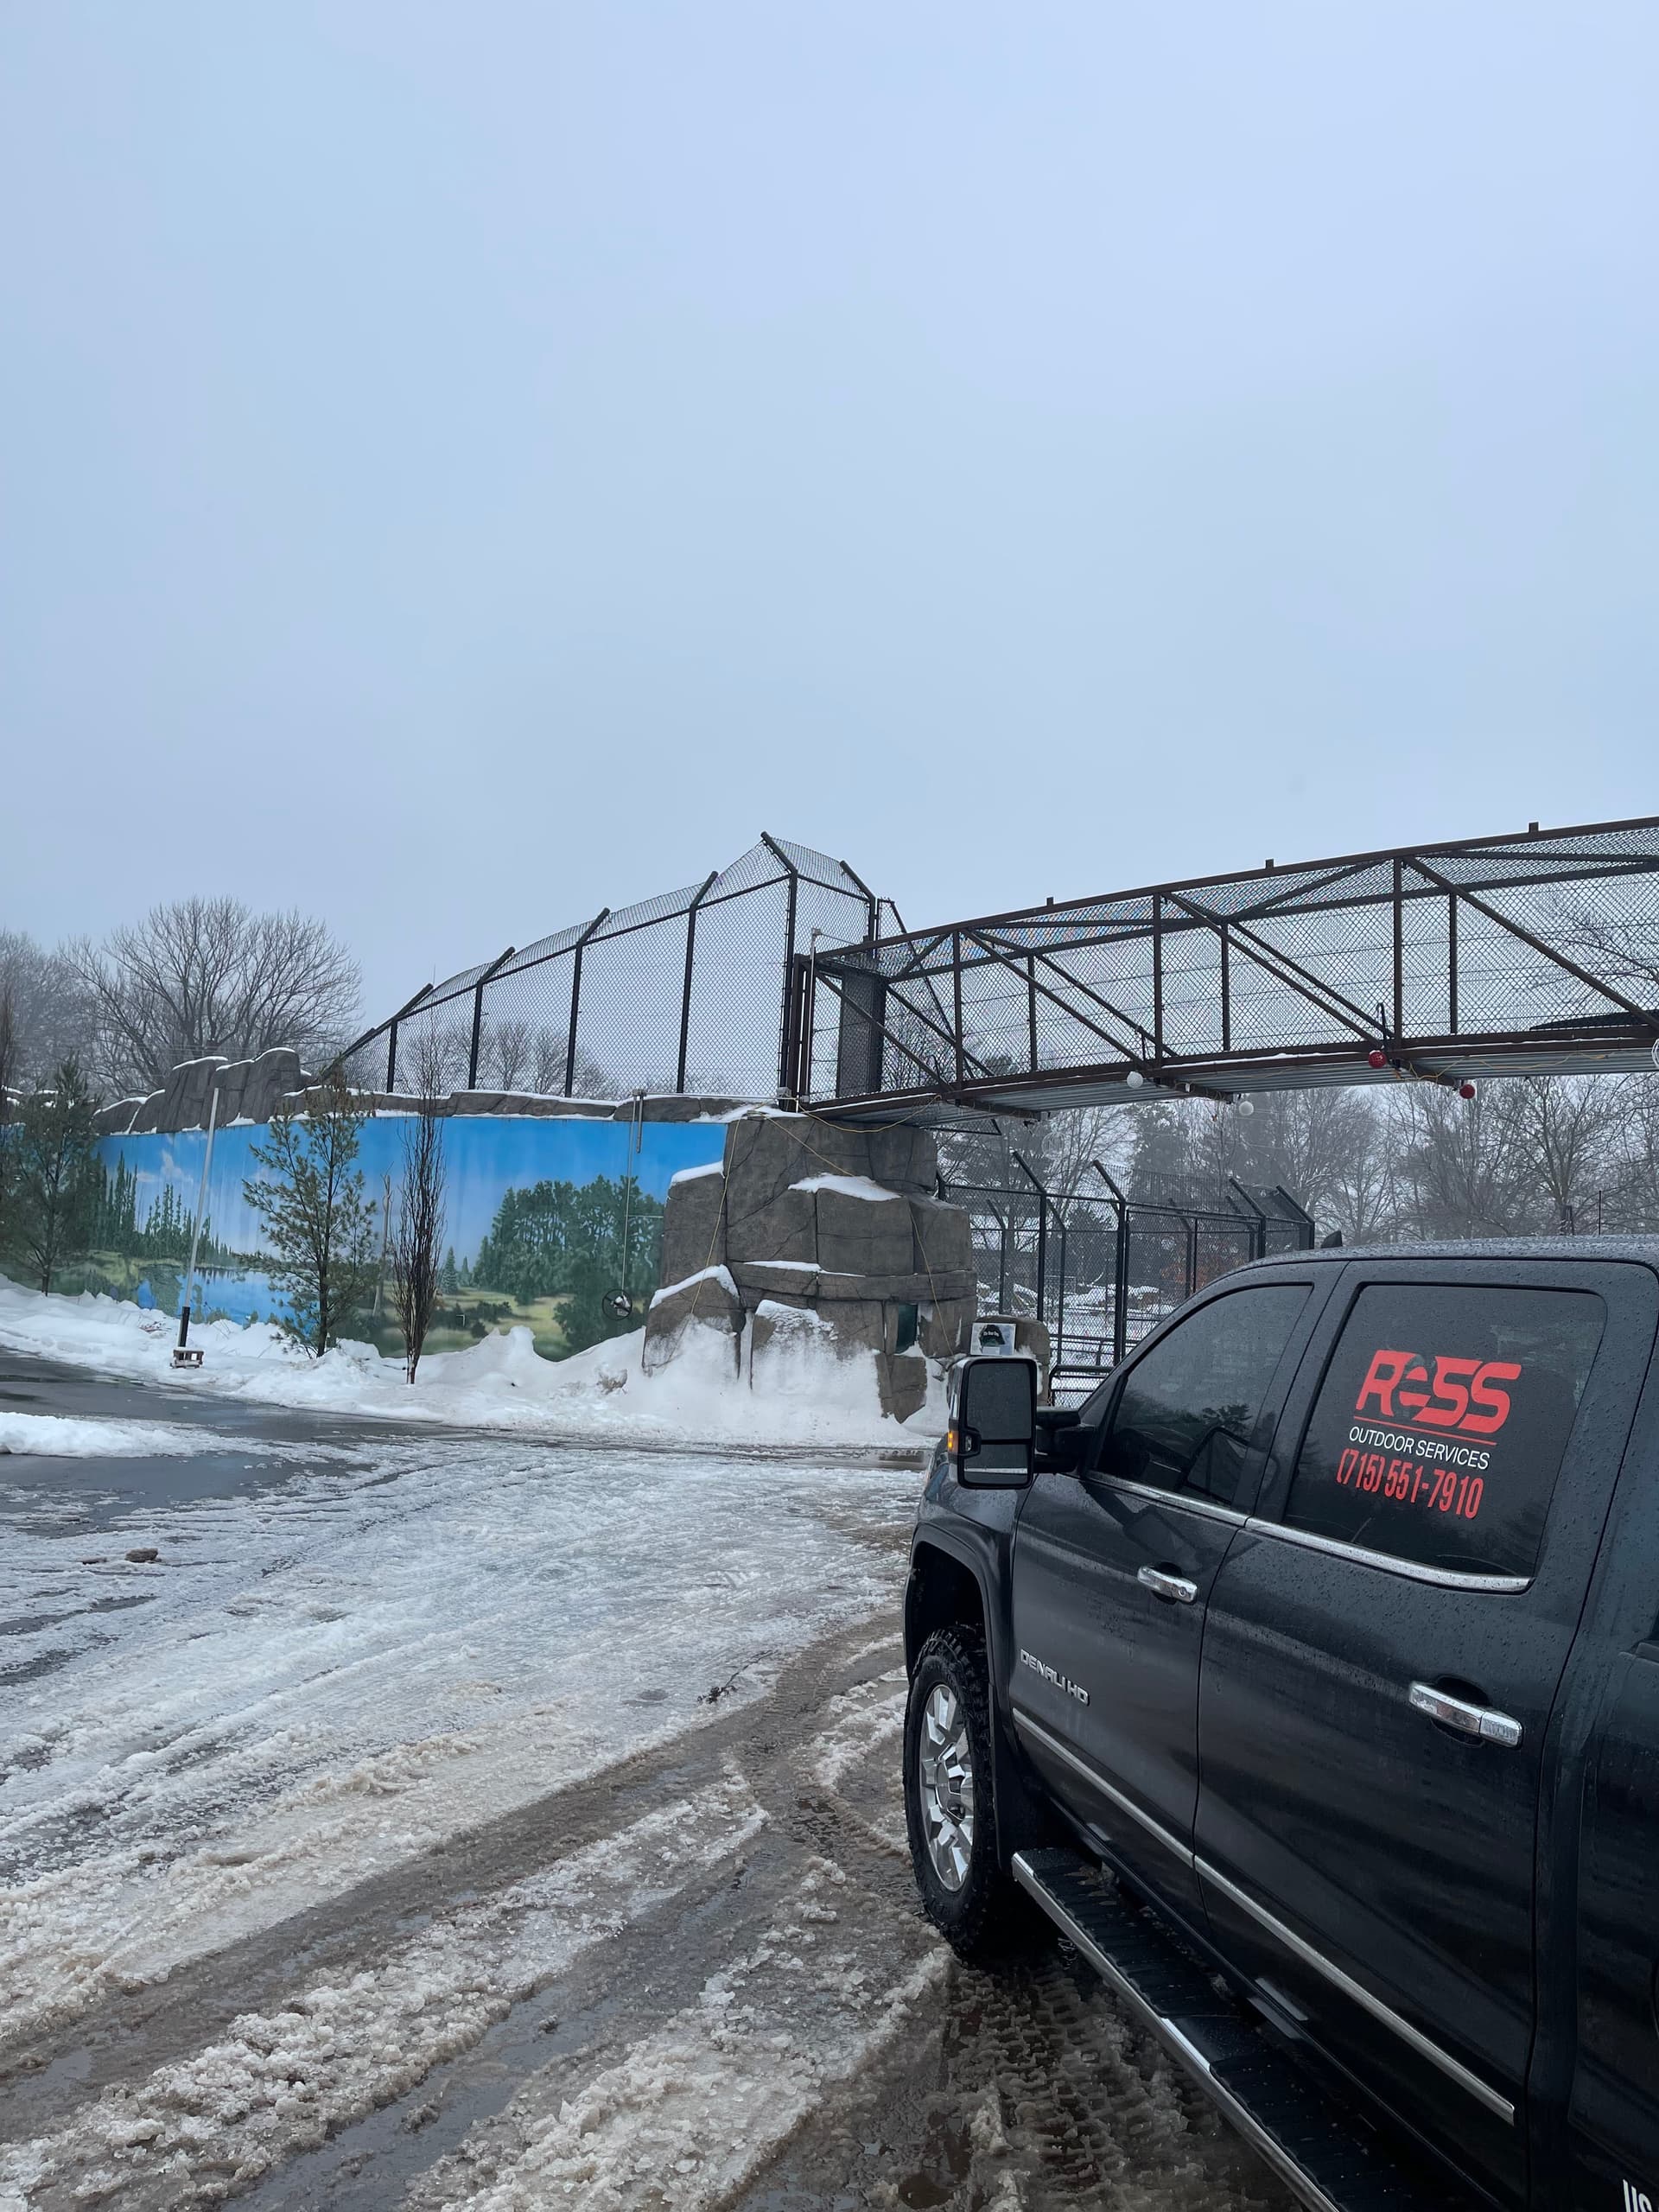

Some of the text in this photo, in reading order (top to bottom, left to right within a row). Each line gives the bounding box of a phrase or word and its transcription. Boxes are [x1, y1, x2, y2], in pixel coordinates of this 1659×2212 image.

[1349, 1426, 1491, 1470] OUTDOOR SERVICES
[1337, 1448, 1484, 1519] (715) 551-7910
[1020, 1649, 1089, 1705] DENALI HD
